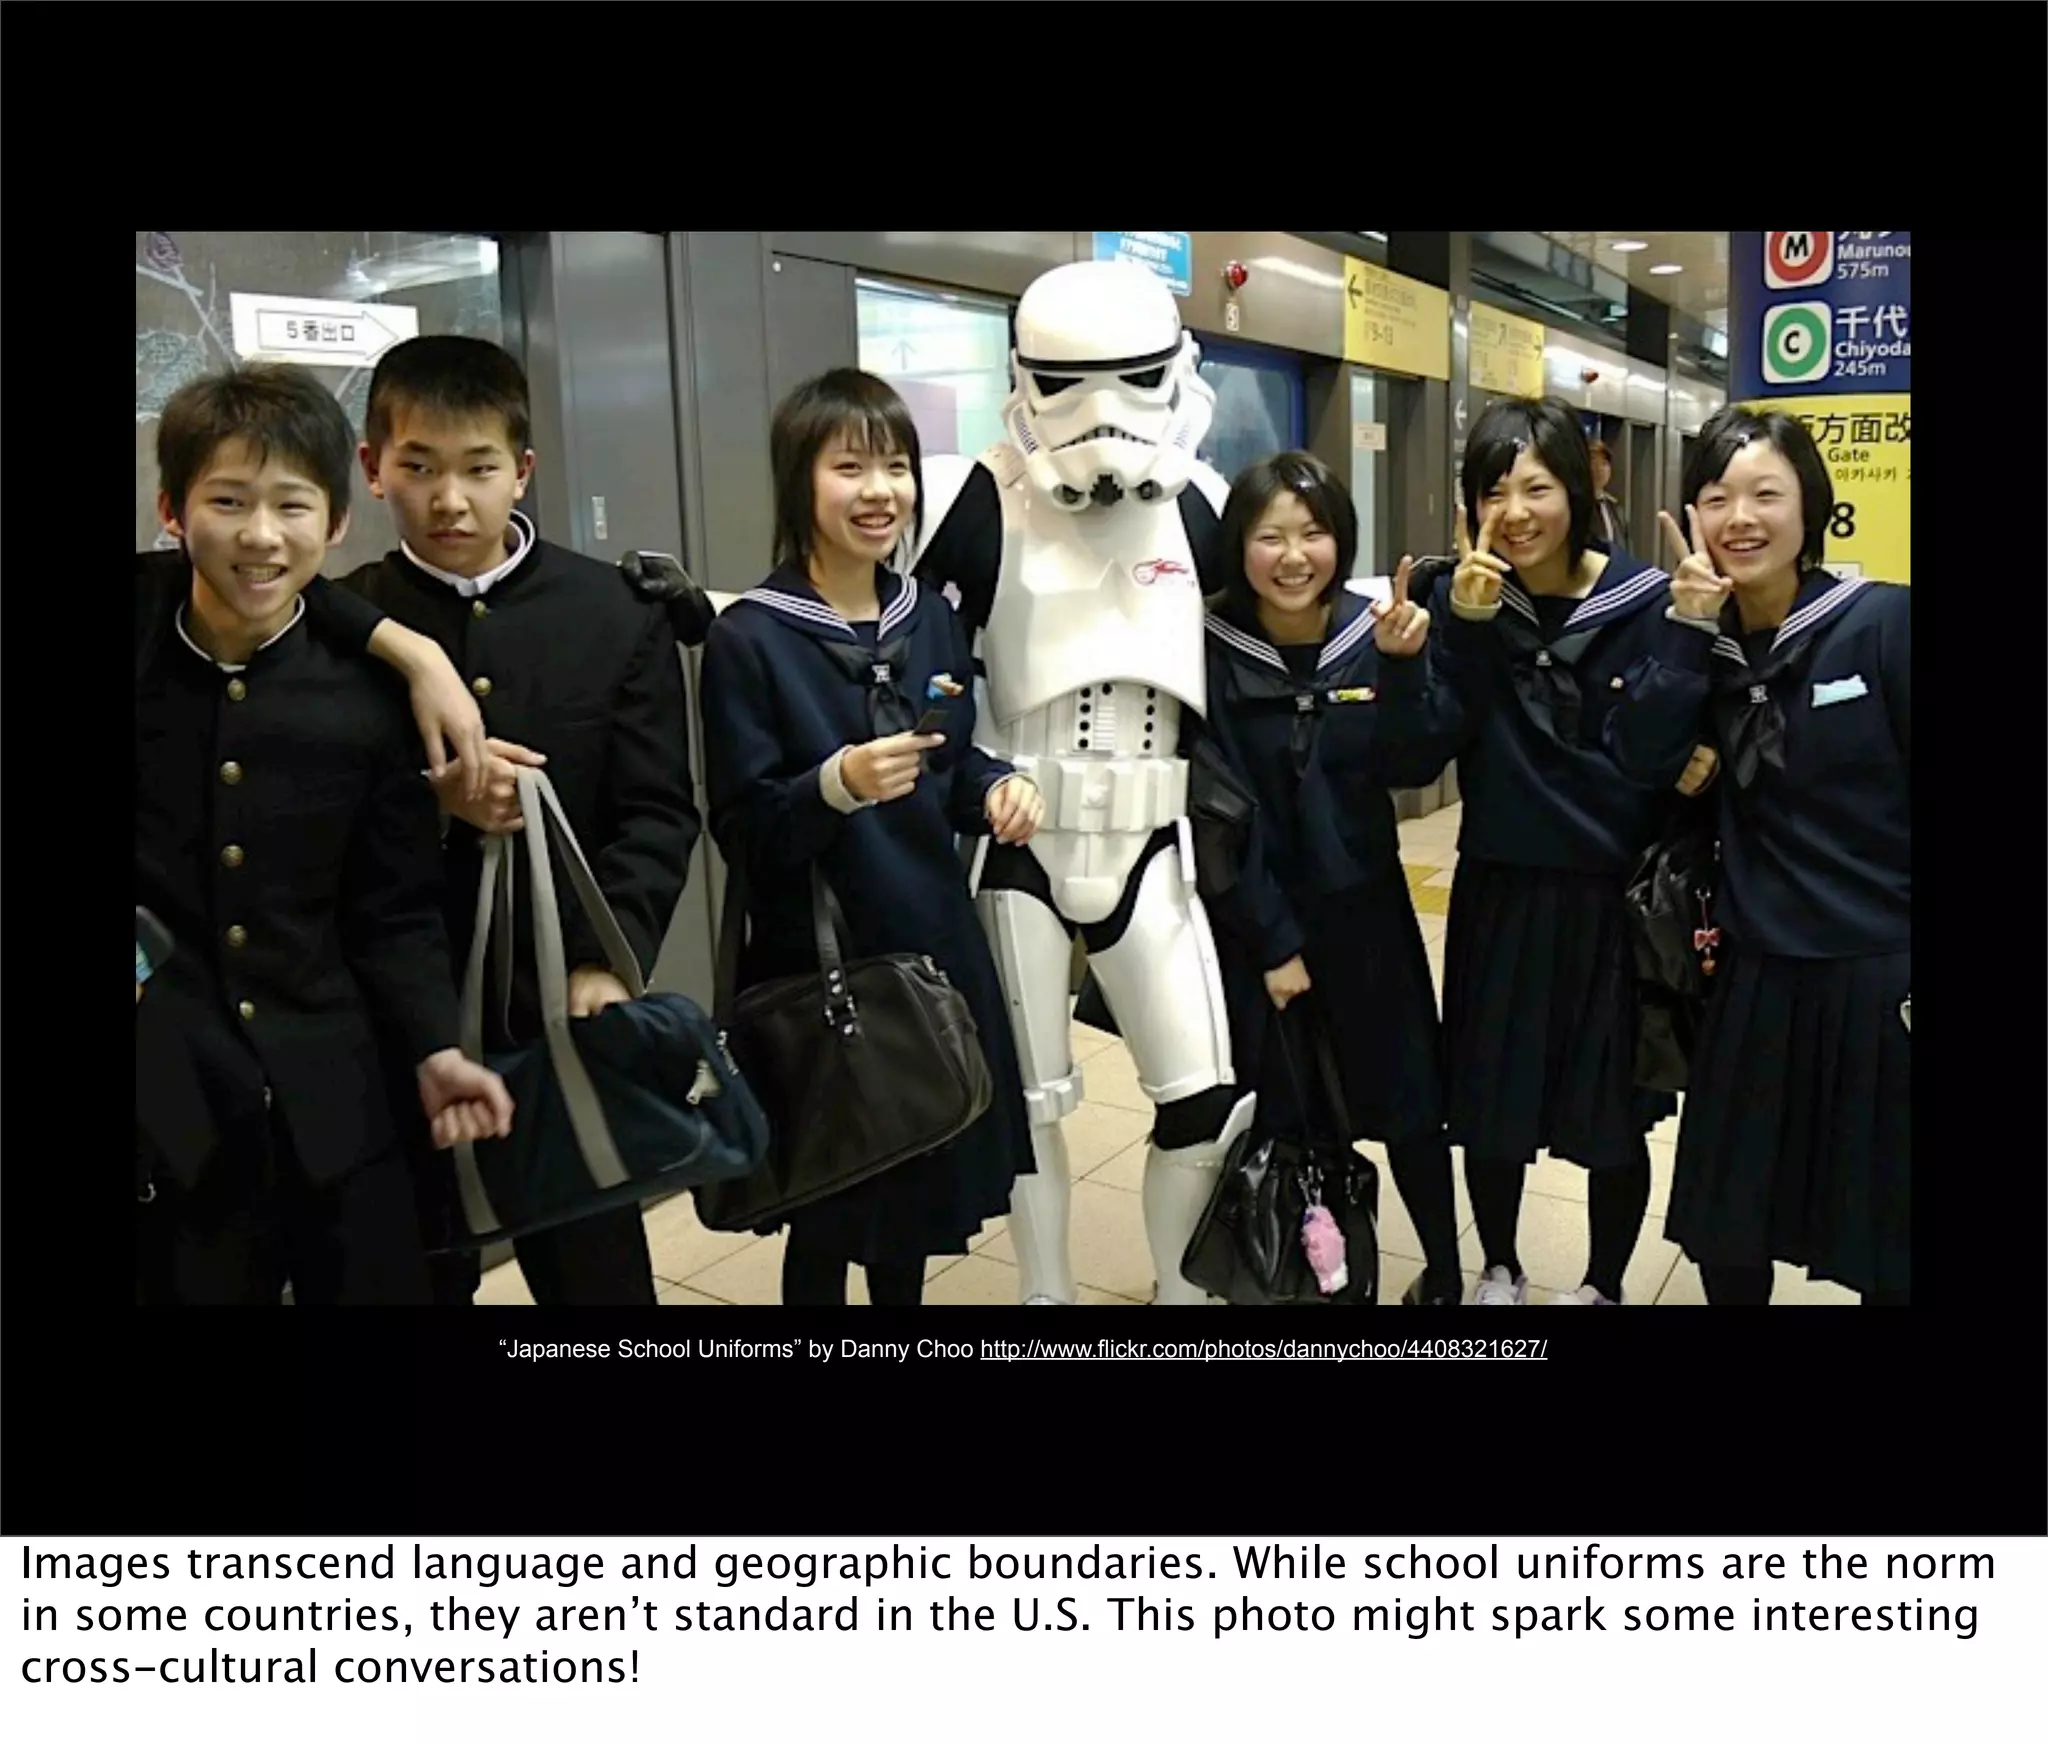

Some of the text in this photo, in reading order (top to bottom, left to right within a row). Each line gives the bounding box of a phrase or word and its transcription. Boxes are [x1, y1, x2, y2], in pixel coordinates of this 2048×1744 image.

[1784, 233, 1809, 259] M
[1837, 261, 1889, 280] 575m
[1835, 304, 1908, 339] 千代
[1784, 330, 1800, 355] C
[1833, 360, 1887, 377] 245m
[1827, 447, 1870, 463] Gate
[1829, 501, 1856, 539] 8
